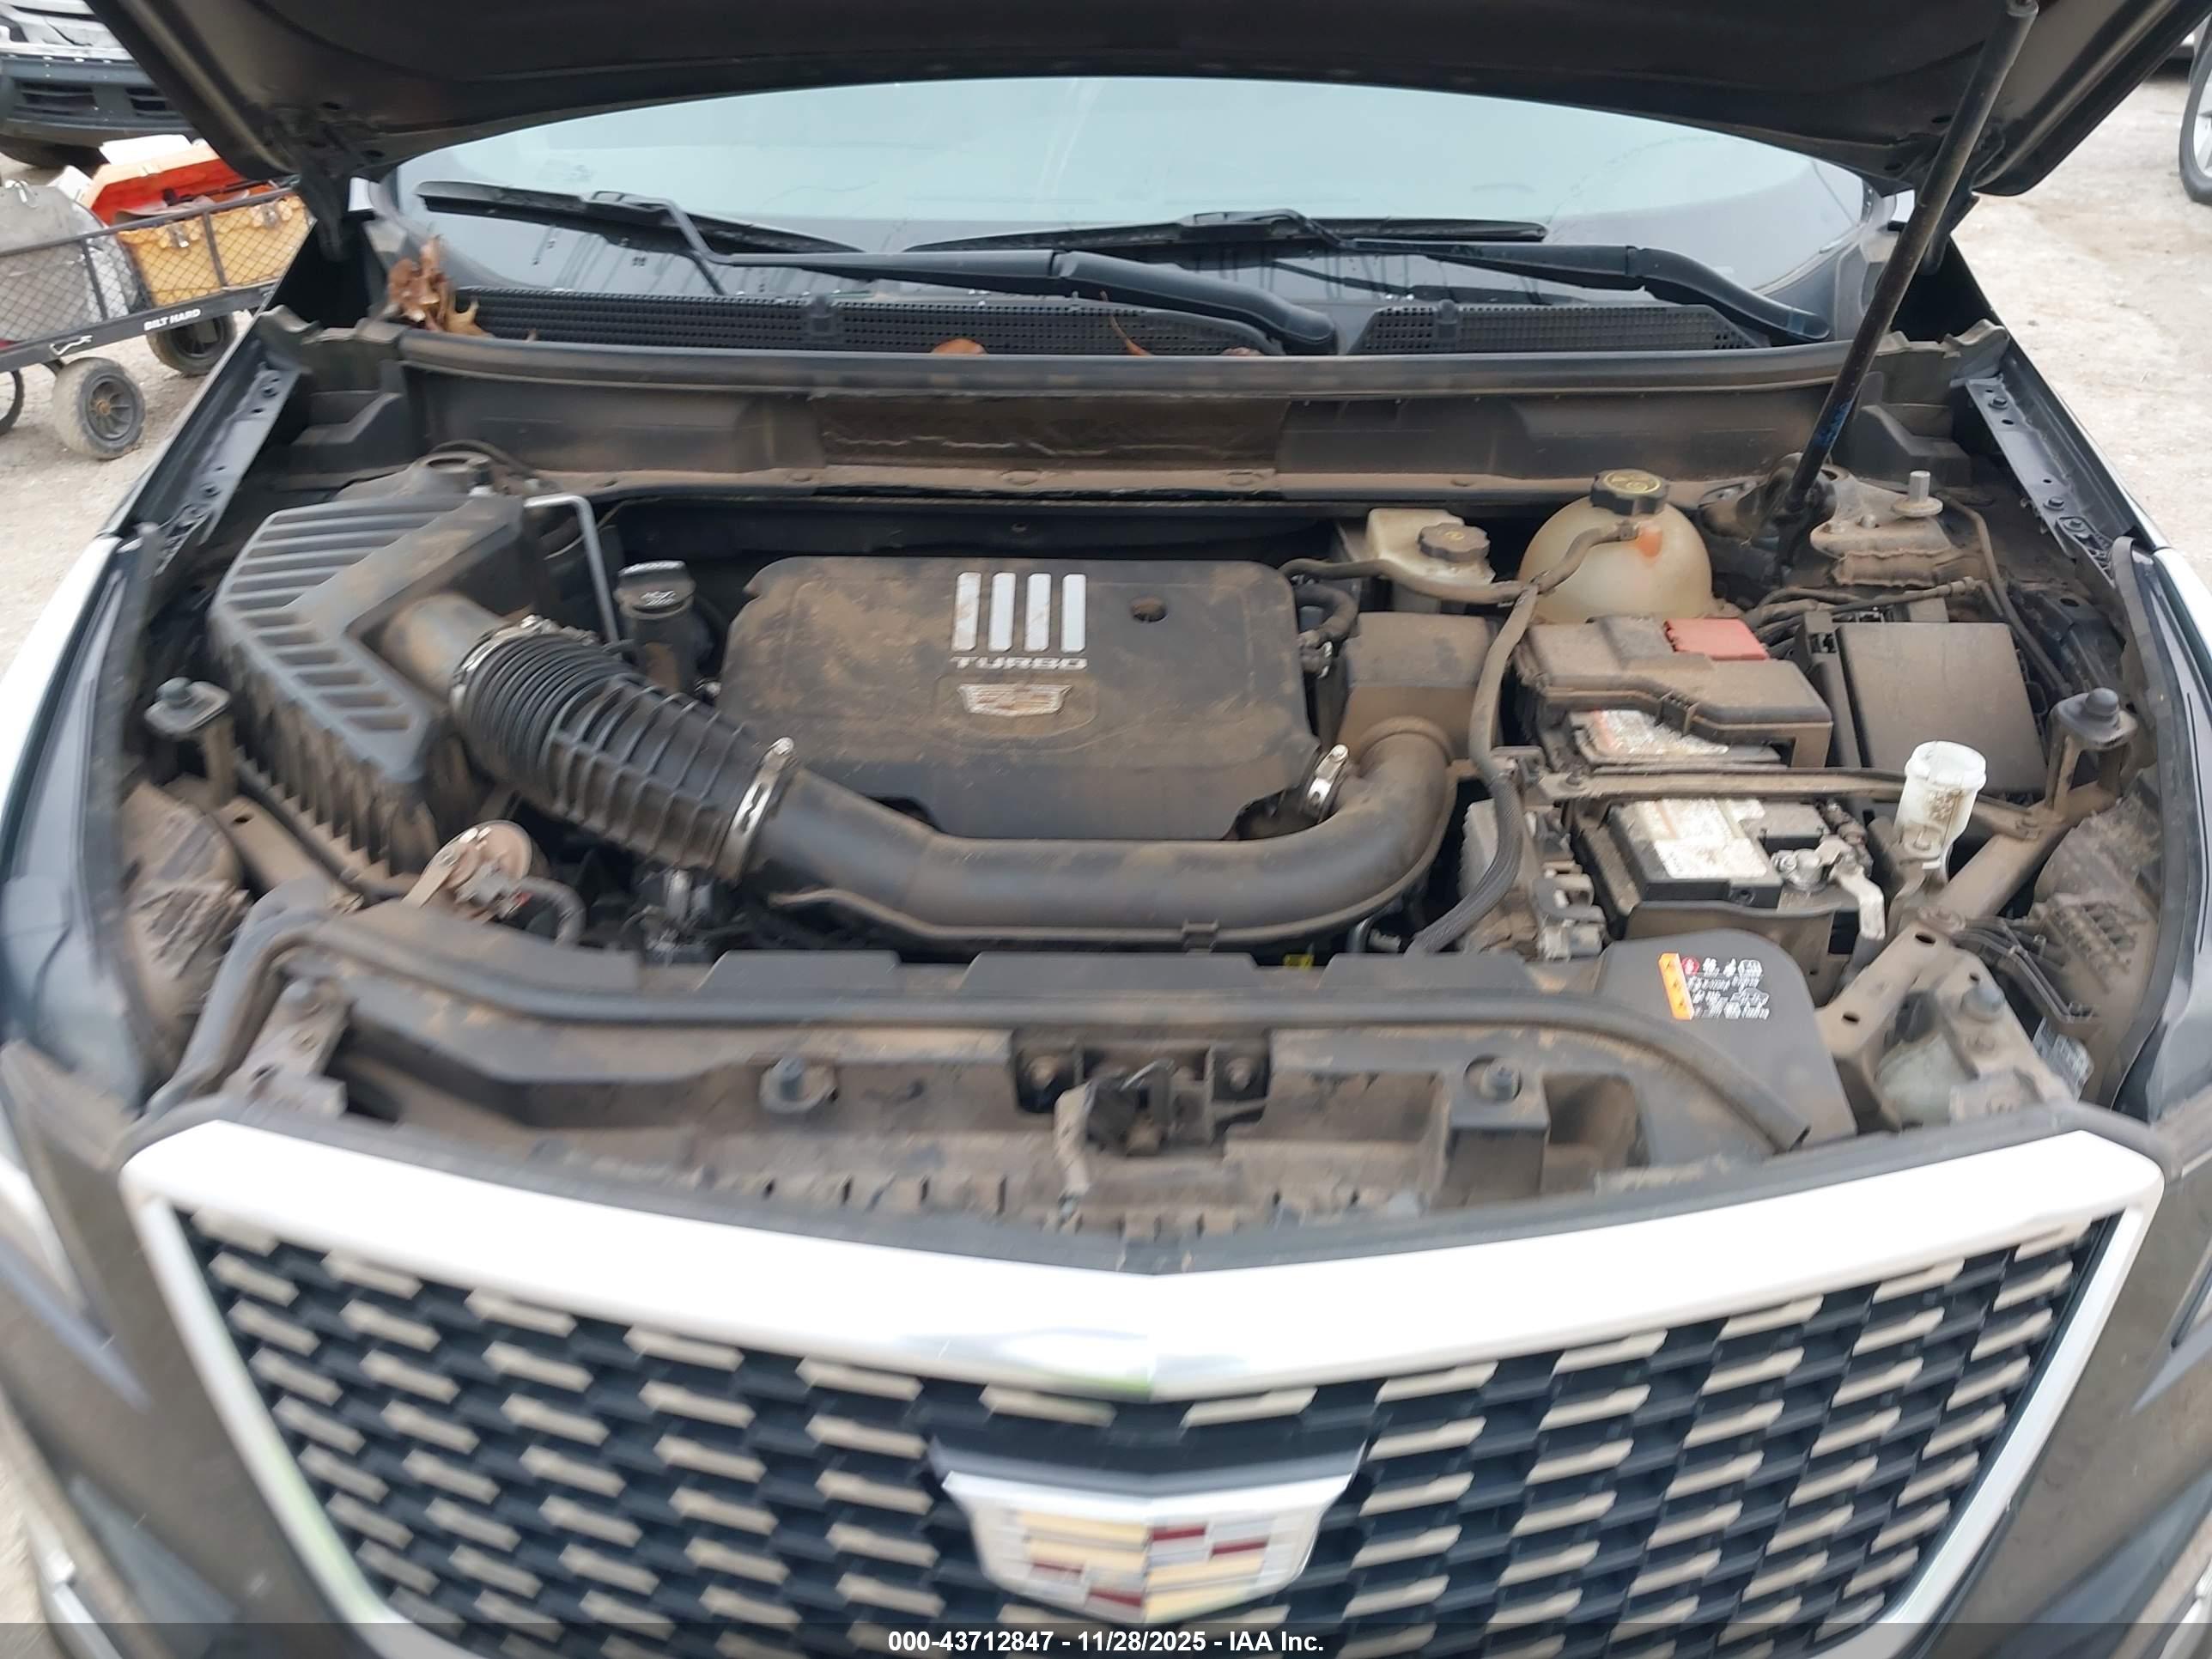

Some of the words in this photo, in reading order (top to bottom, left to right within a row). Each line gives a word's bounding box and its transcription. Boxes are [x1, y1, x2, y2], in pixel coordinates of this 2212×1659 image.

[143, 316, 169, 331] BILT
[169, 308, 201, 325] HARD
[950, 656, 1088, 671] TURBO
